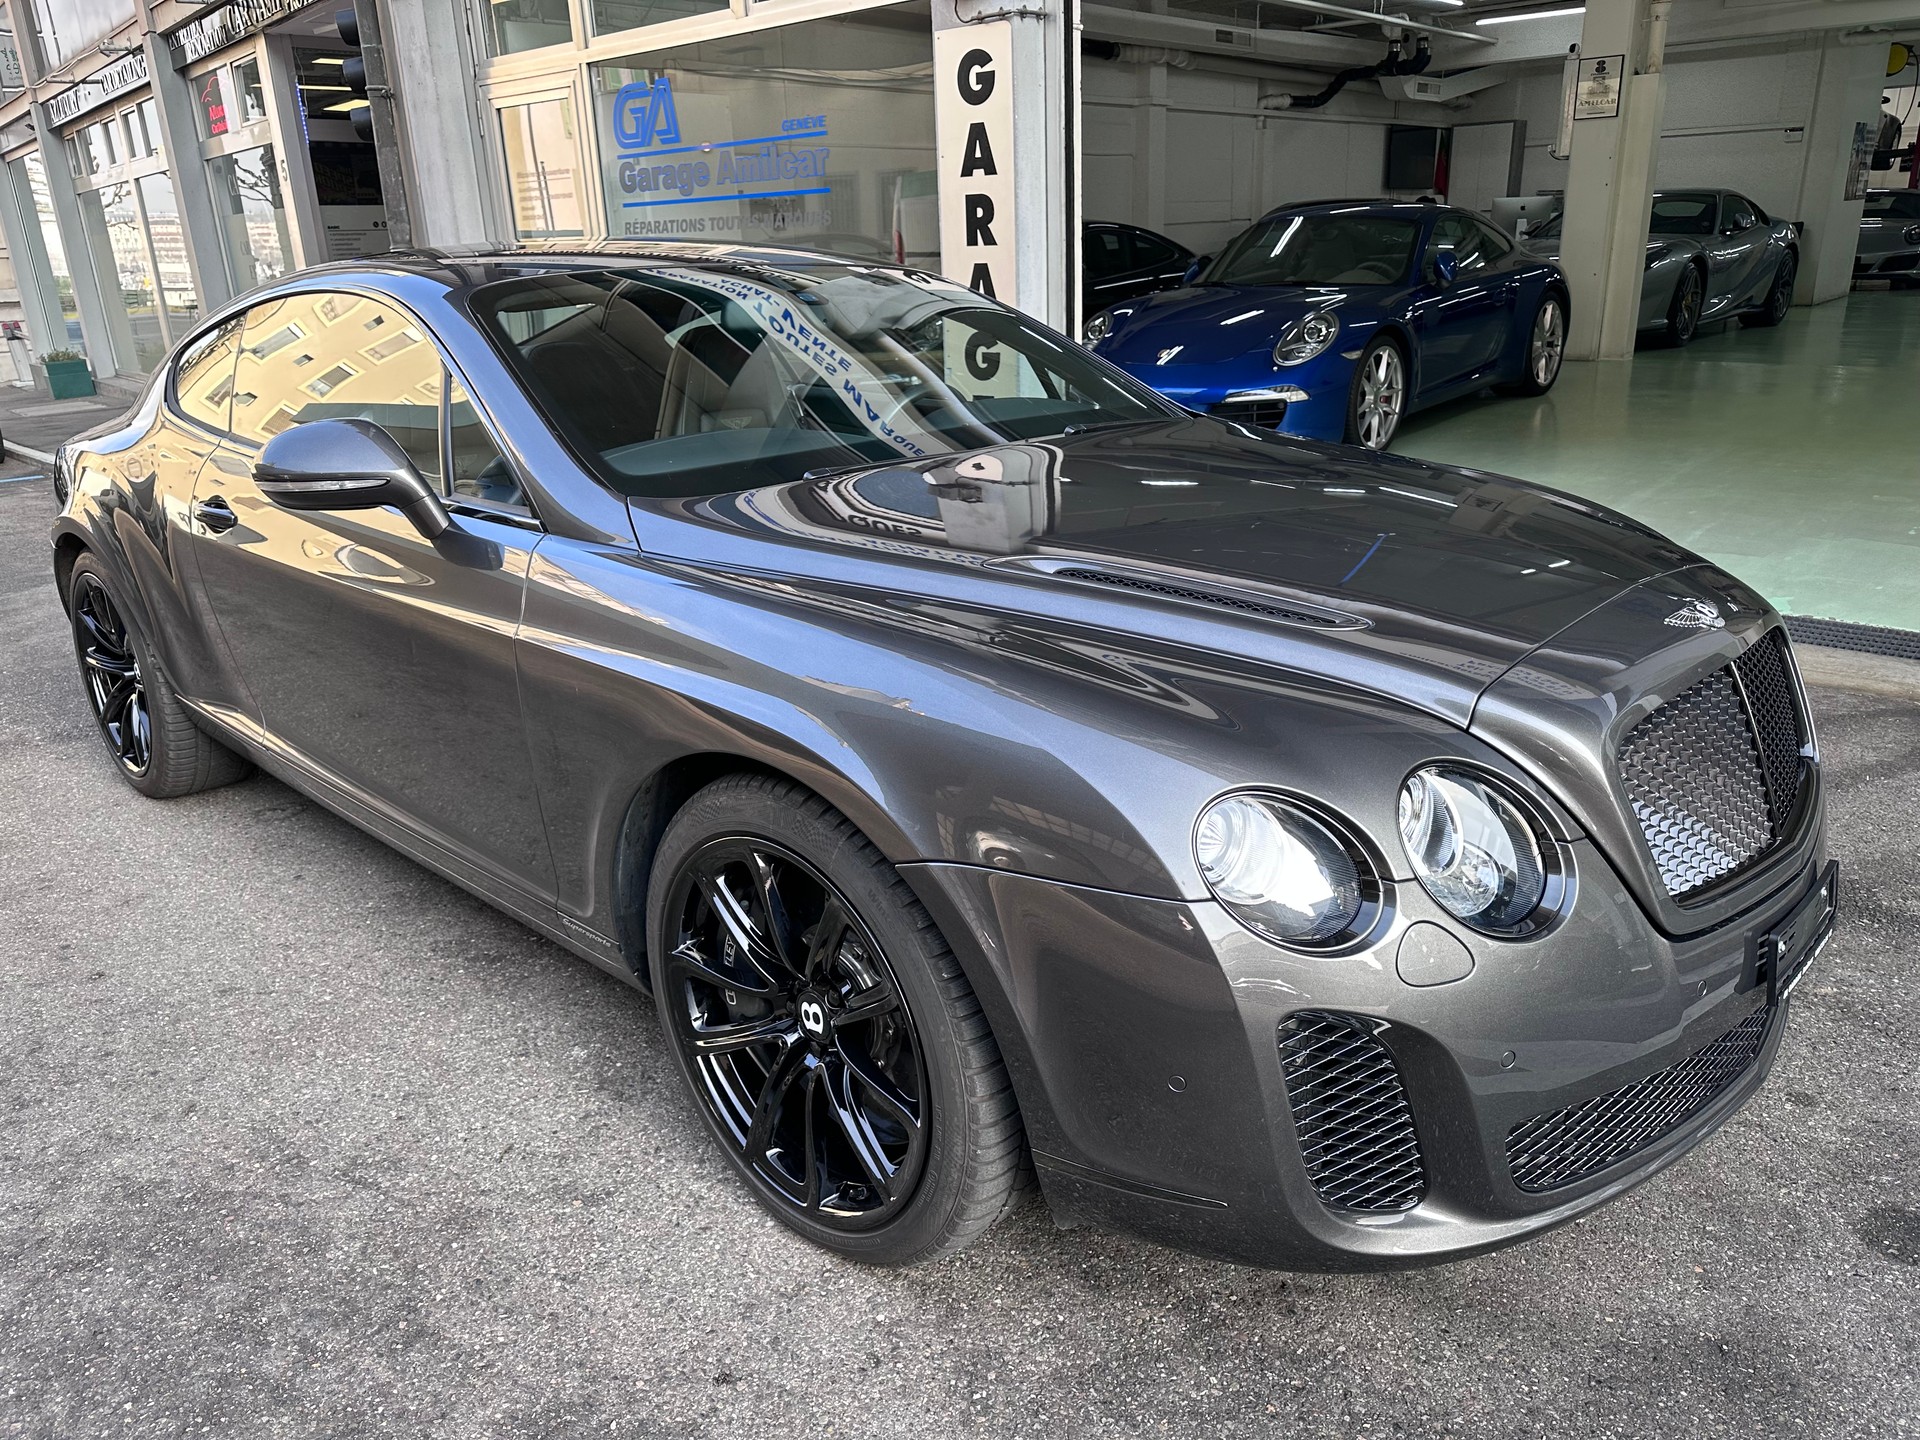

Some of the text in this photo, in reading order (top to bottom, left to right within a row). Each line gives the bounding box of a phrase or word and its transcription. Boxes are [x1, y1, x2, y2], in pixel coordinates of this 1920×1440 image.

[613, 77, 681, 149] GA
[1578, 98, 1617, 107] AMILCAR
[618, 161, 711, 197] Garage
[716, 143, 831, 185] Amilcar
[624, 217, 706, 236] RÉPARATIONS
[708, 213, 763, 234] TOUTES
[561, 917, 612, 948] Supersports
[801, 1001, 824, 1035] B
